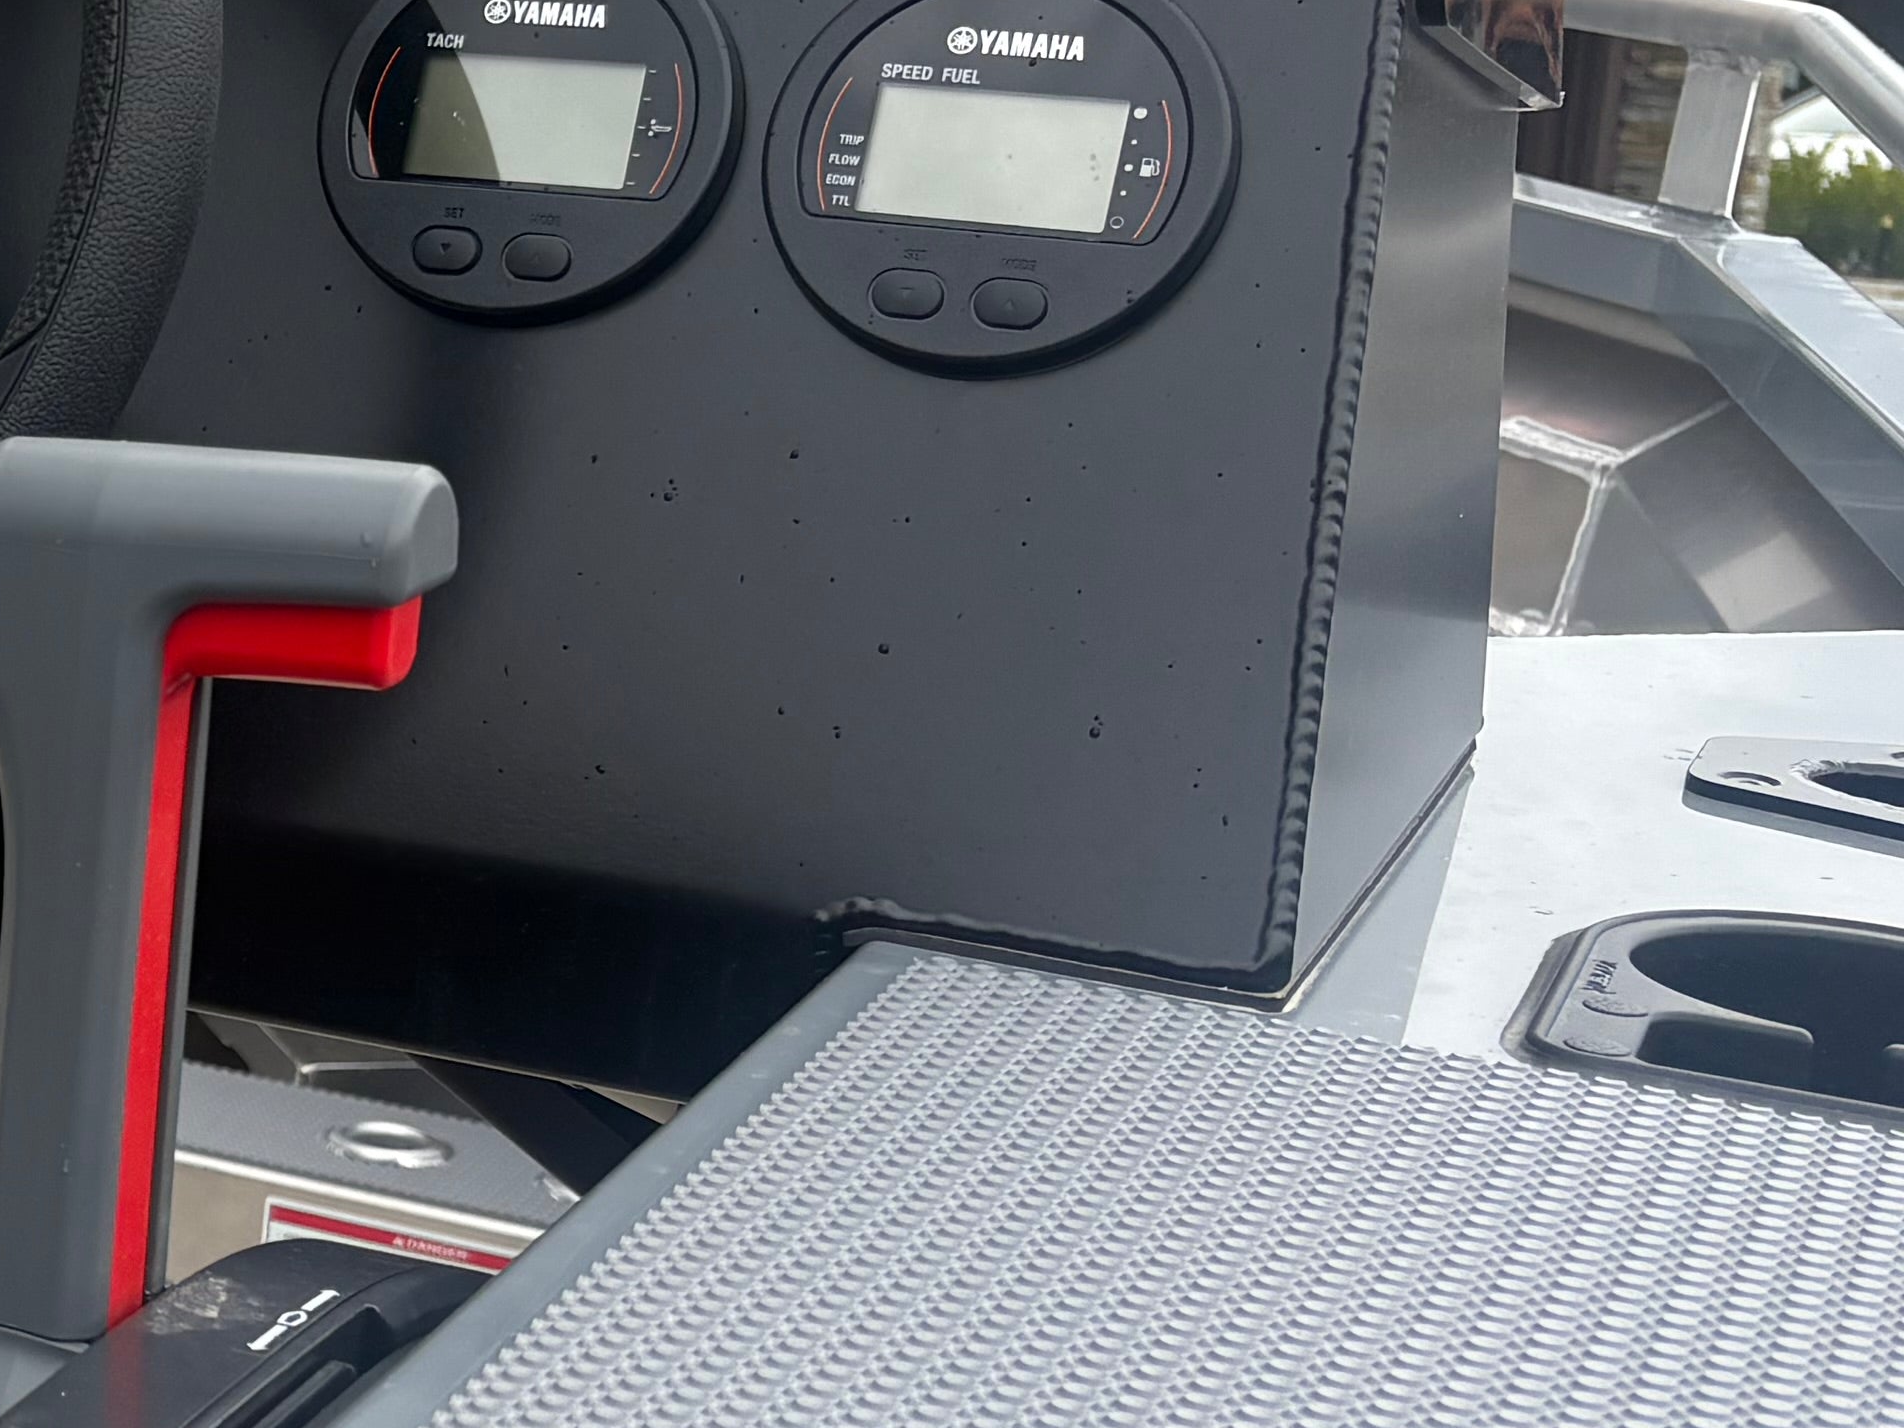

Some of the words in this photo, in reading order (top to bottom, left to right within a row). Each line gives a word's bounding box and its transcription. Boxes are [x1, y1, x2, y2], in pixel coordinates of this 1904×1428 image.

[513, 0, 607, 29] YAMAHA
[426, 32, 465, 49] TACH
[980, 29, 1085, 61] YAMAHA
[881, 63, 934, 81] SPEED
[941, 67, 981, 85] FUEL
[840, 133, 865, 146] TRIP
[828, 153, 861, 166] FLOW
[825, 173, 856, 187] ECON
[832, 194, 851, 207] TTL
[444, 207, 465, 219] SET
